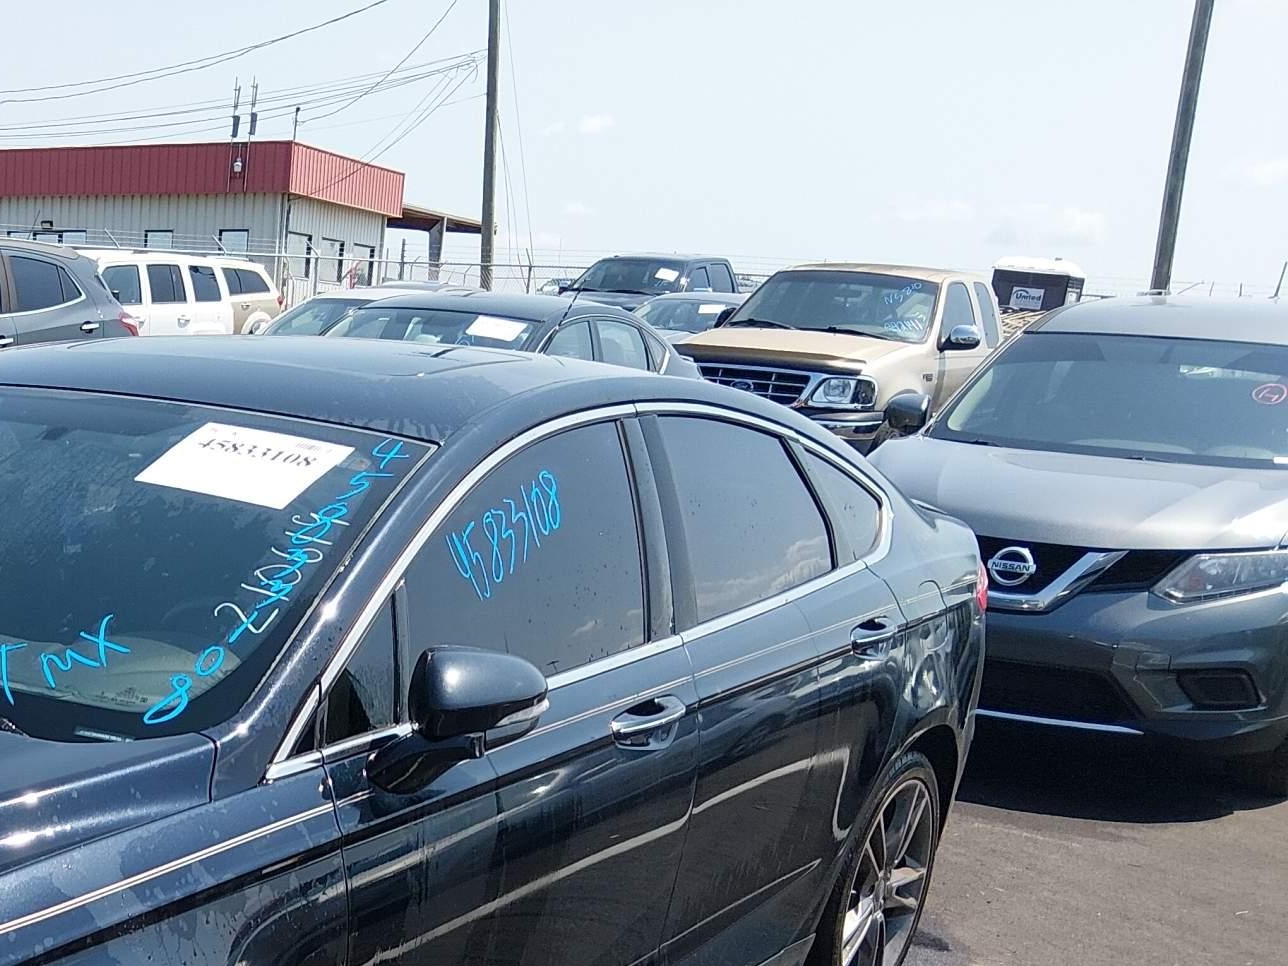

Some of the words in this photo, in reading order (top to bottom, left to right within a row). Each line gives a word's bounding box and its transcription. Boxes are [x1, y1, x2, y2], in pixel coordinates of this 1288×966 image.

[1016, 292, 1042, 301] United
[199, 438, 318, 467] 45833108
[445, 470, 561, 601] 45833108
[992, 561, 1031, 573] NISSAN
